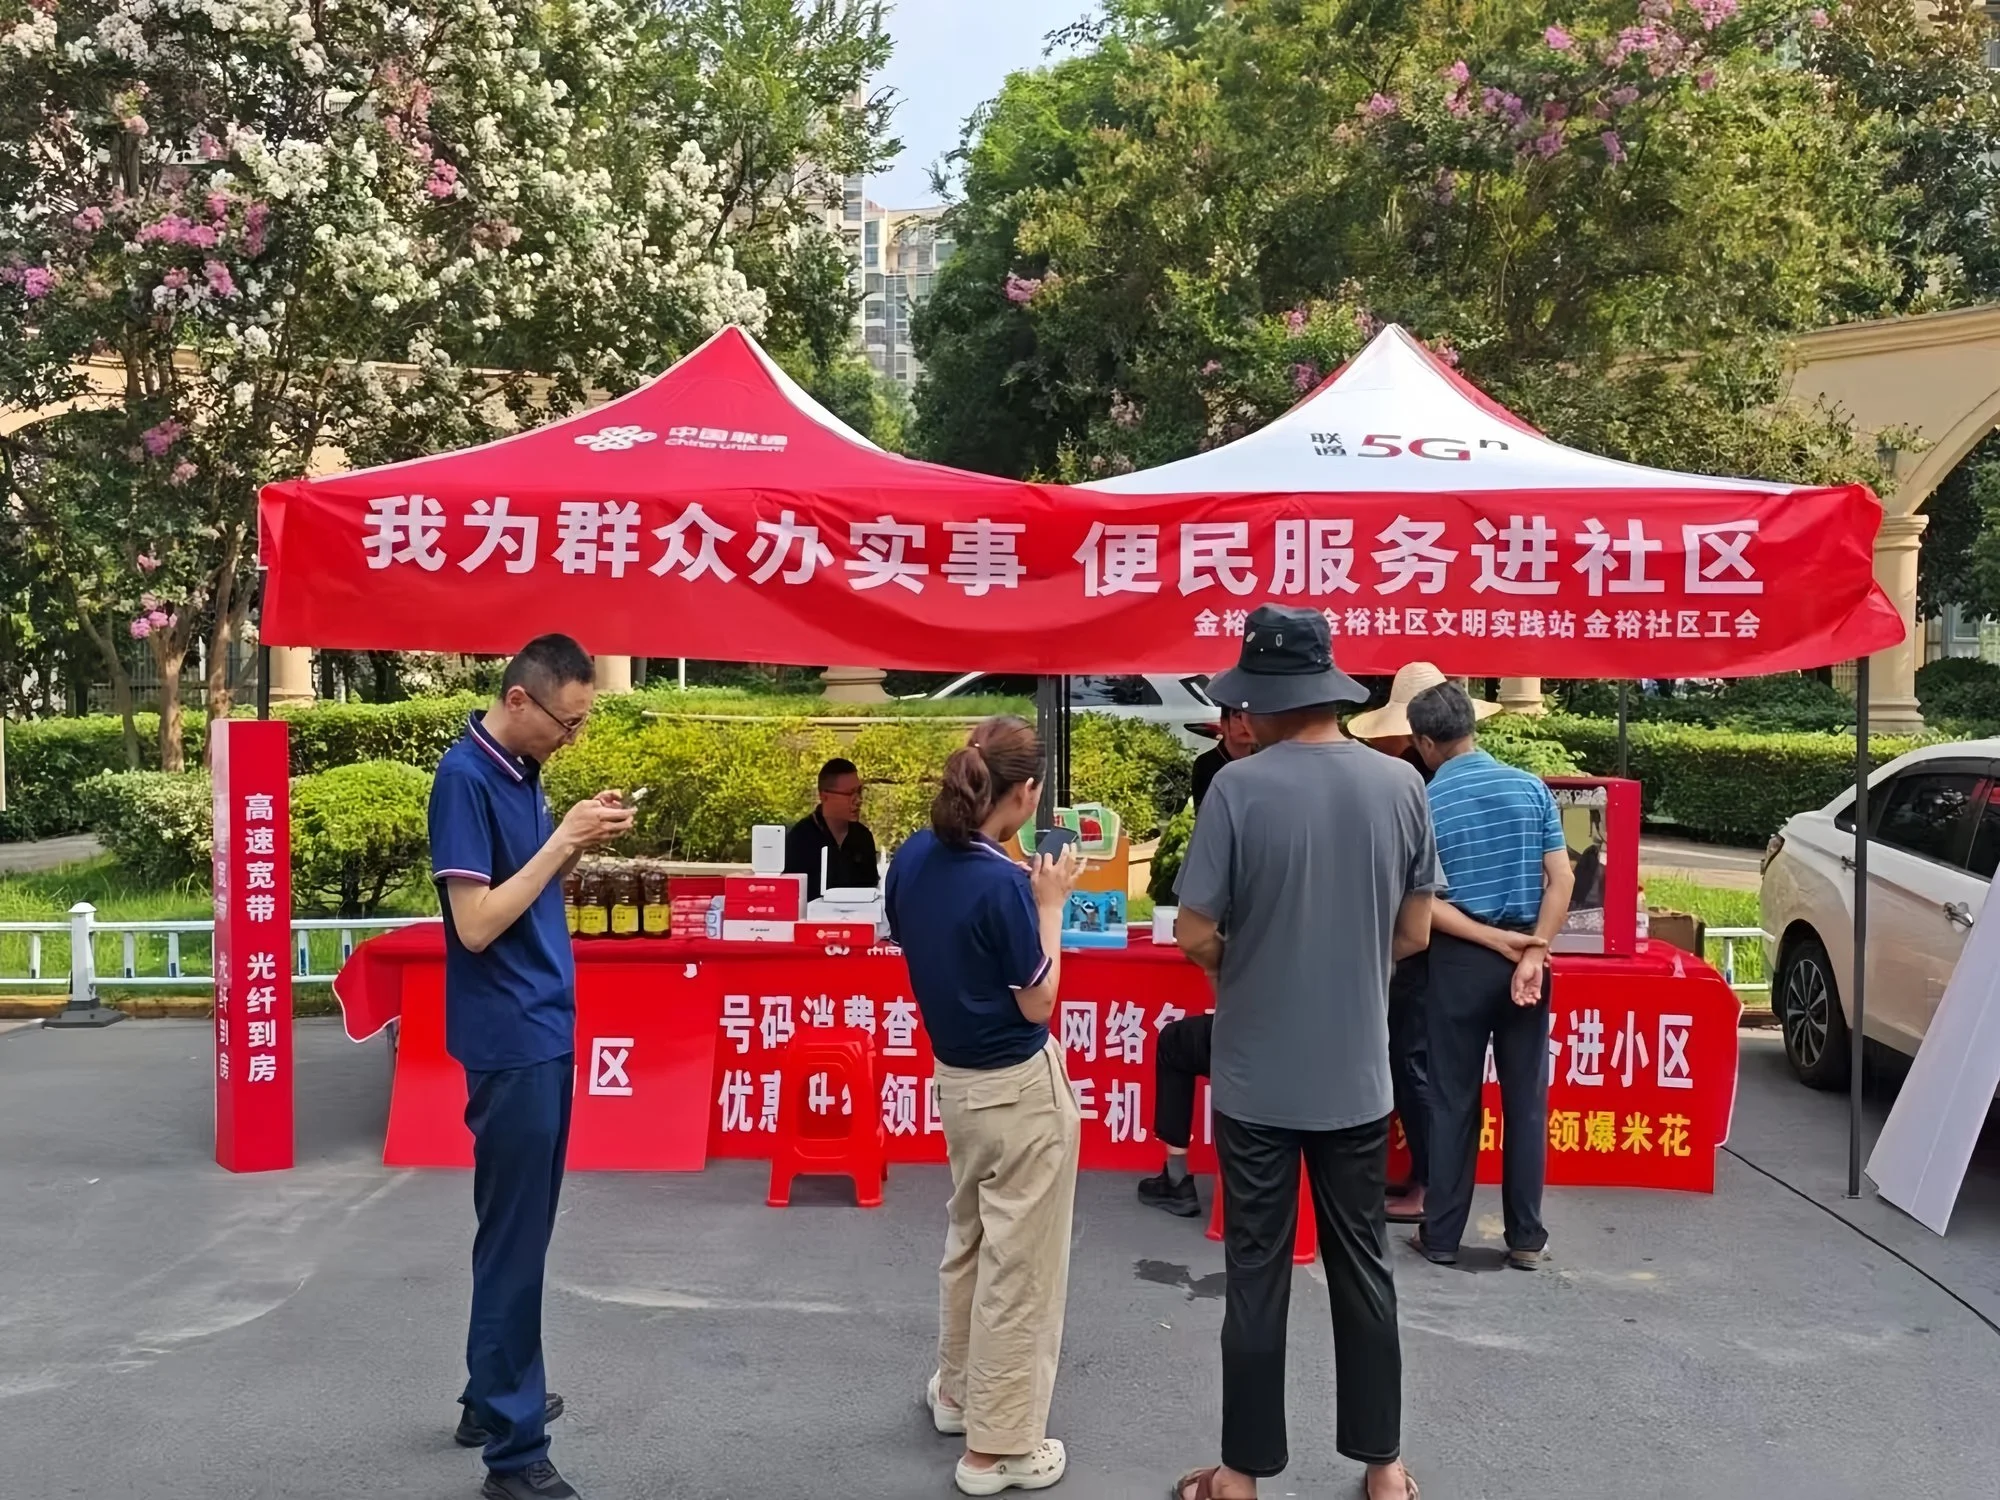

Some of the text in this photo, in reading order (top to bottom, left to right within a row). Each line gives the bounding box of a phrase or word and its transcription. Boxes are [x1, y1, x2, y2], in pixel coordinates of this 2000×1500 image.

[363, 495, 1764, 598] 我为群众办实事 便民服务进社区
[1584, 608, 1760, 640] 金裕社区工会
[245, 792, 277, 1083] 高速宽带 光纤到房
[588, 1037, 635, 1096] 区
[1549, 1108, 1691, 1157] 领爆米花
